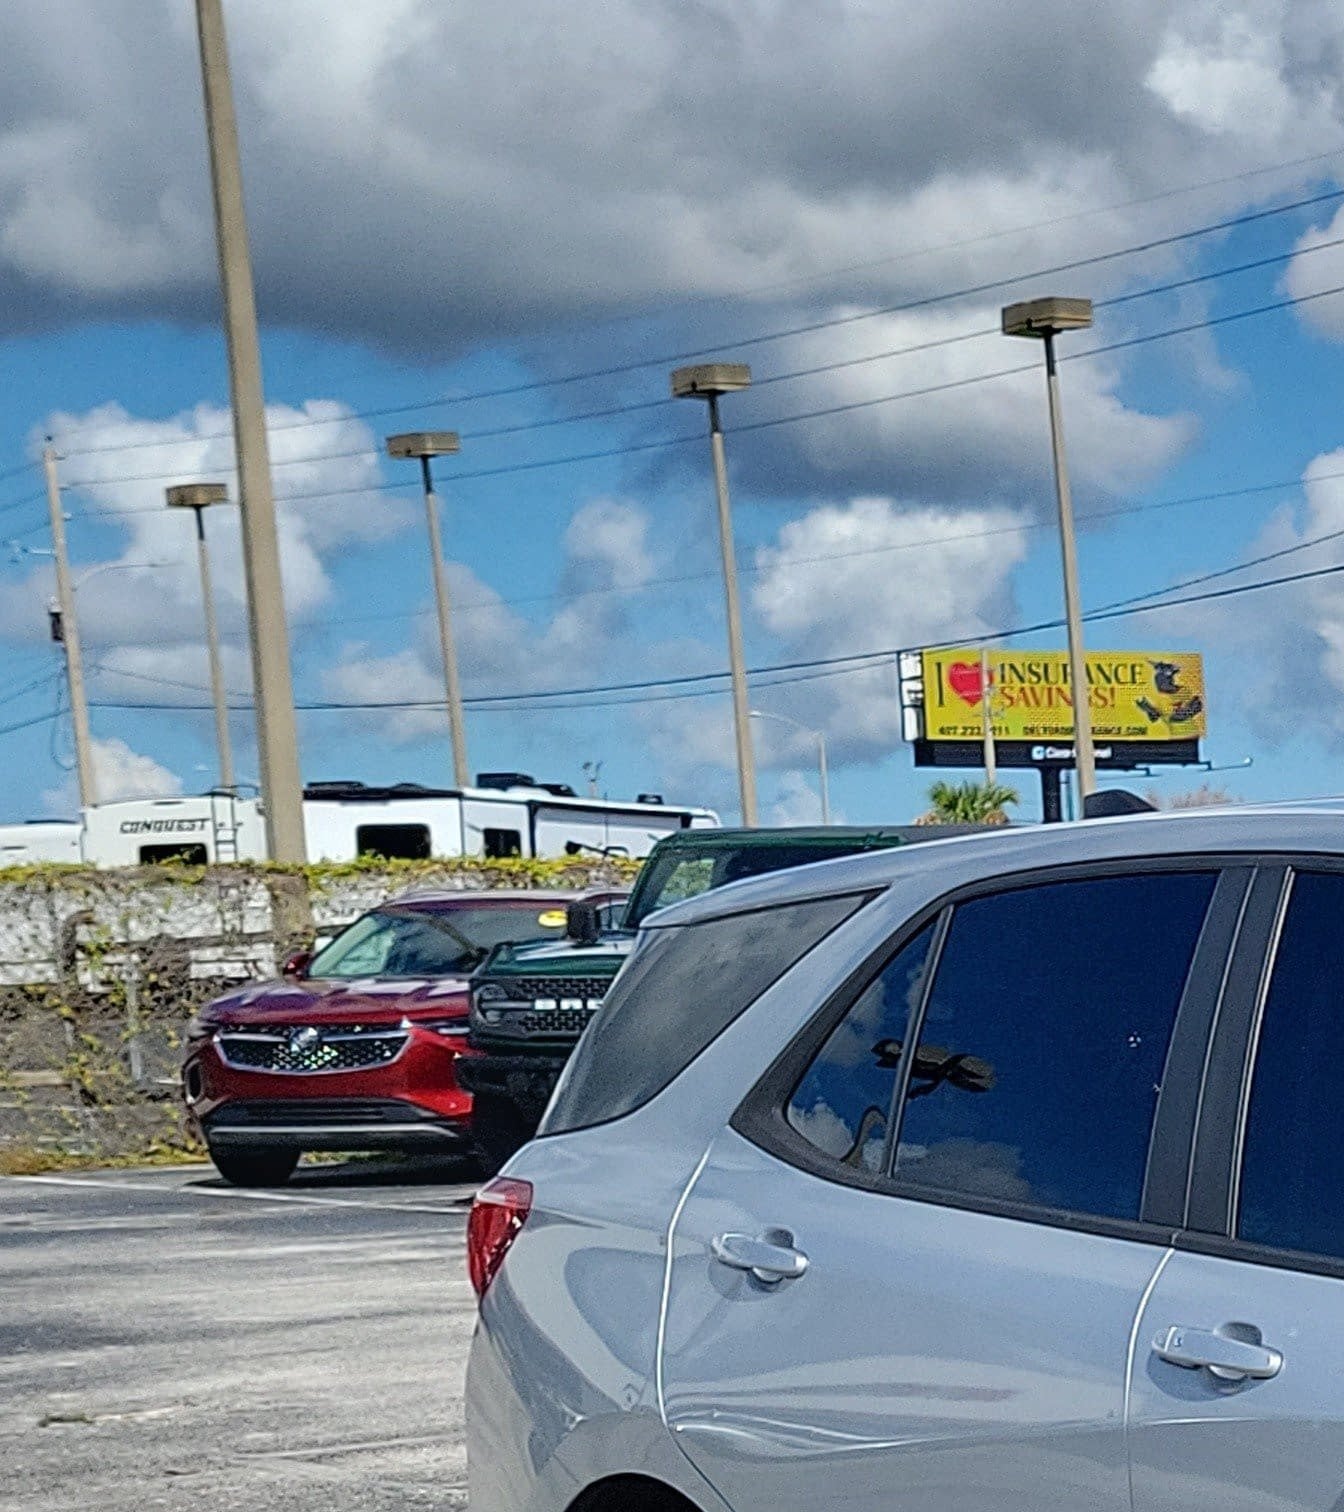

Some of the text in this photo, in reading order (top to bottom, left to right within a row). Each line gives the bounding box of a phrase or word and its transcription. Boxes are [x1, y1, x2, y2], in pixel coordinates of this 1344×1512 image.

[1001, 685, 1118, 708] SAVINS!
[119, 817, 211, 834] CONQUEST
[534, 999, 604, 1011] BRO
